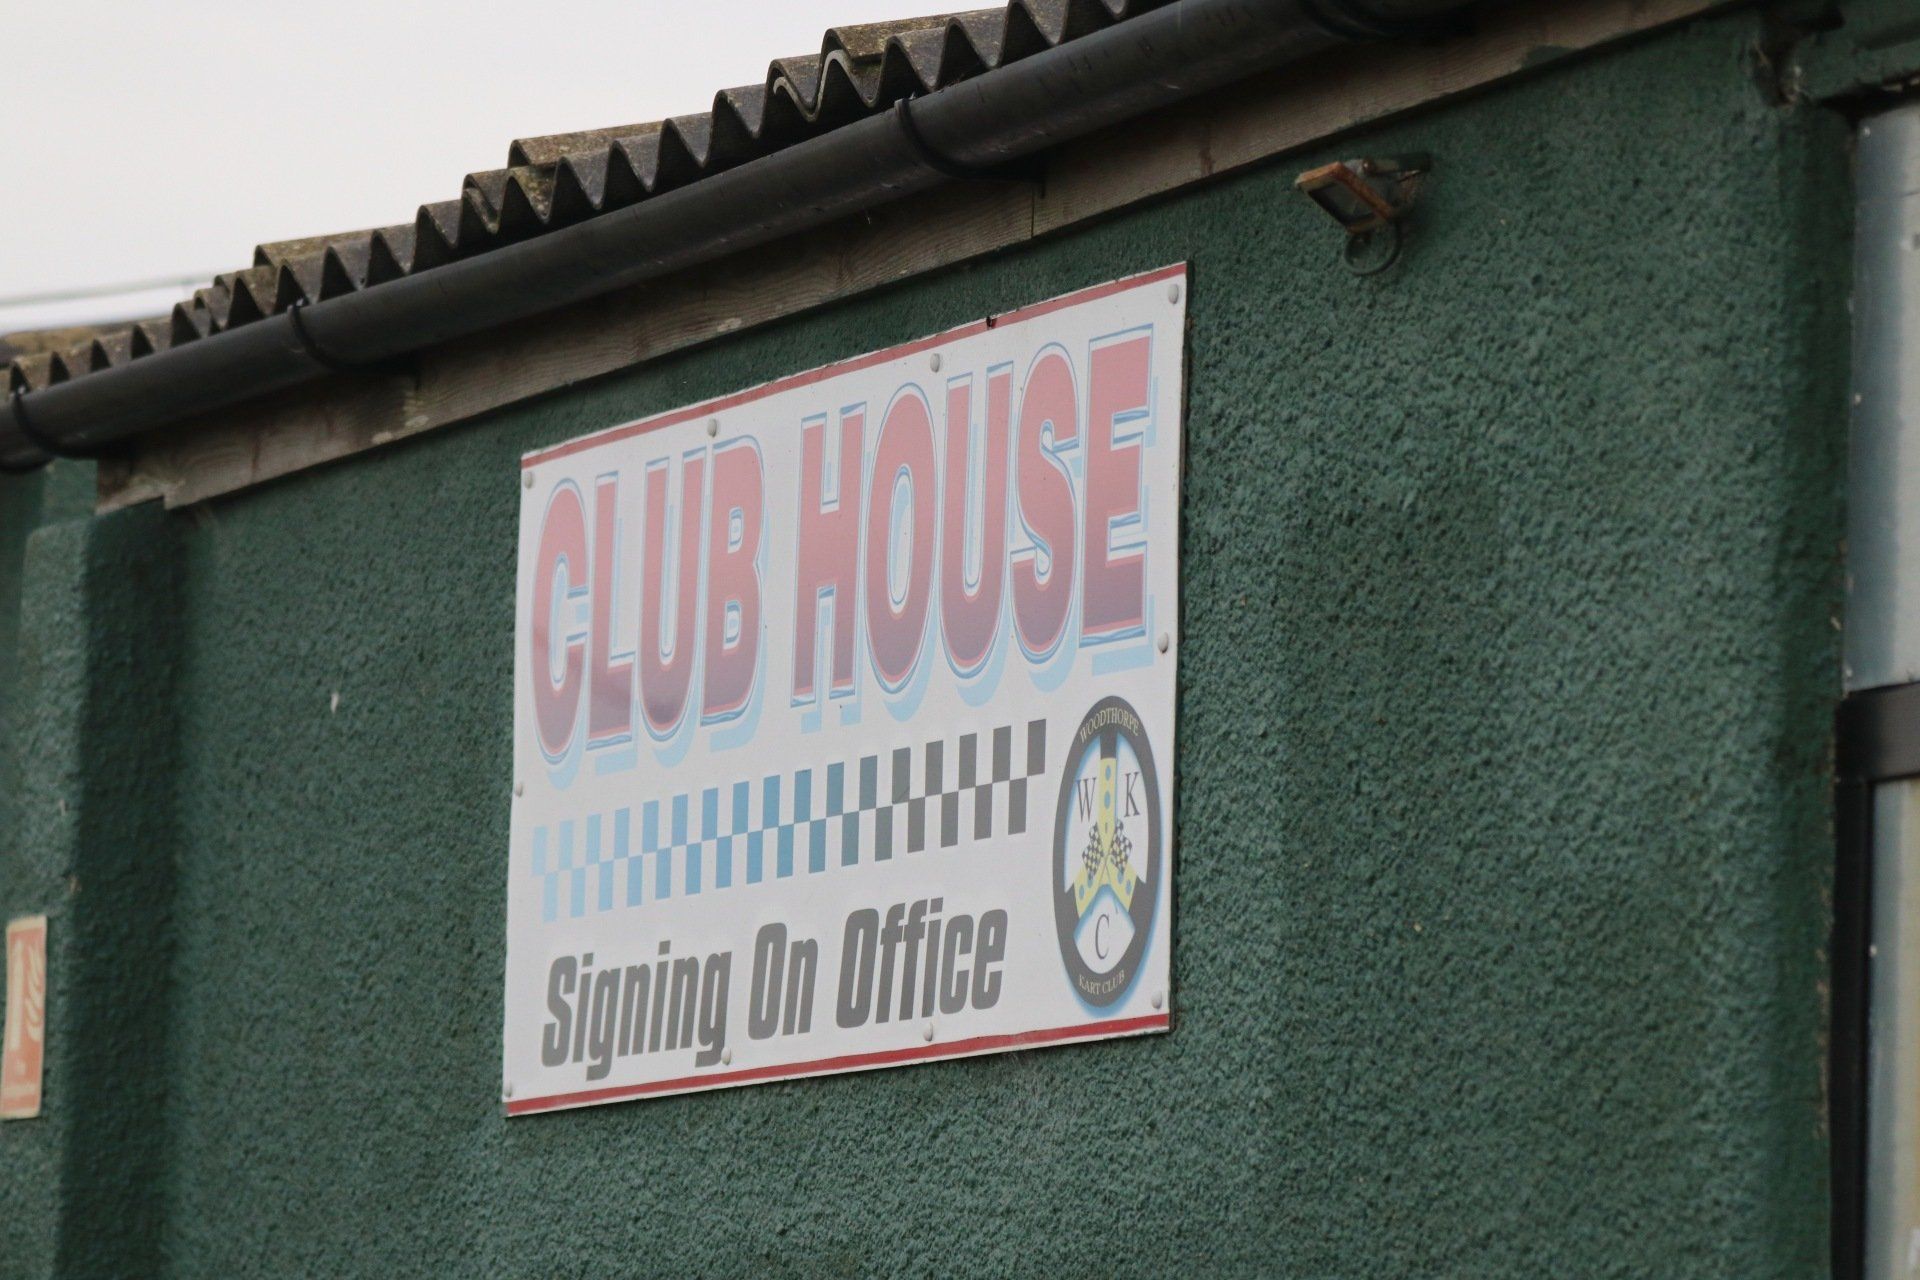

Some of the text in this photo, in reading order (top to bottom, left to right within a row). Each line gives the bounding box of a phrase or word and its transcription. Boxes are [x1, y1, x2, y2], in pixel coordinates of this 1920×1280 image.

[532, 323, 1155, 763] CLUB HOUSE
[1079, 707, 1140, 743] WOODTHORPE
[1075, 771, 1140, 822] W K
[541, 897, 1008, 1081] Signing On Office
[1078, 969, 1125, 996] KART CLUB
